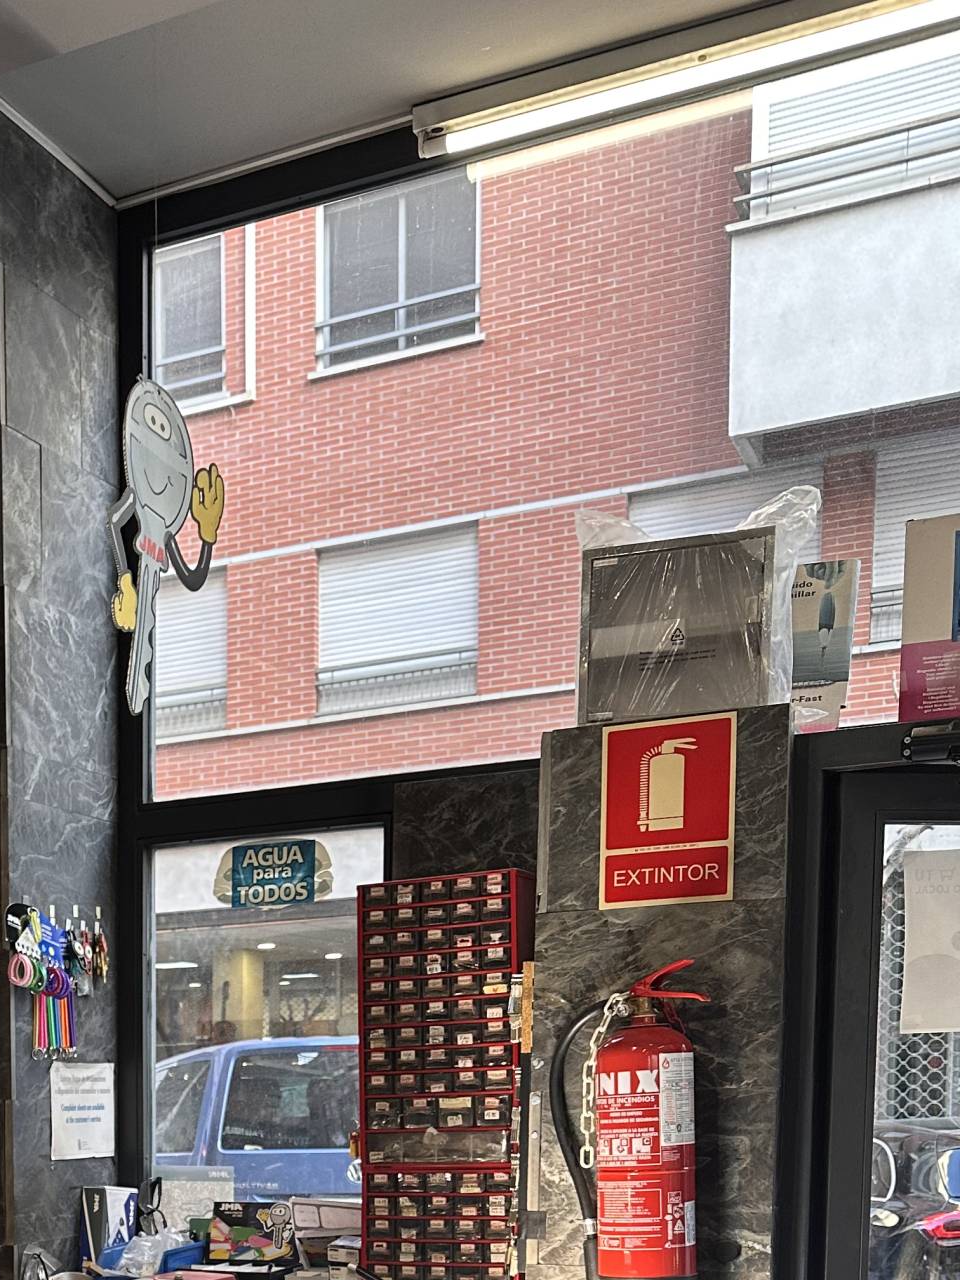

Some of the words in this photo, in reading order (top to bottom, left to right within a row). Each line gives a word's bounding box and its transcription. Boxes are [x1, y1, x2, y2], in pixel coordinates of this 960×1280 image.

[242, 845, 304, 867] AGUA
[253, 866, 292, 884] para
[613, 863, 720, 887] EXTINTOR
[237, 882, 308, 904] TODOS
[595, 1069, 659, 1096] NIX
[219, 1203, 243, 1211] JMA
